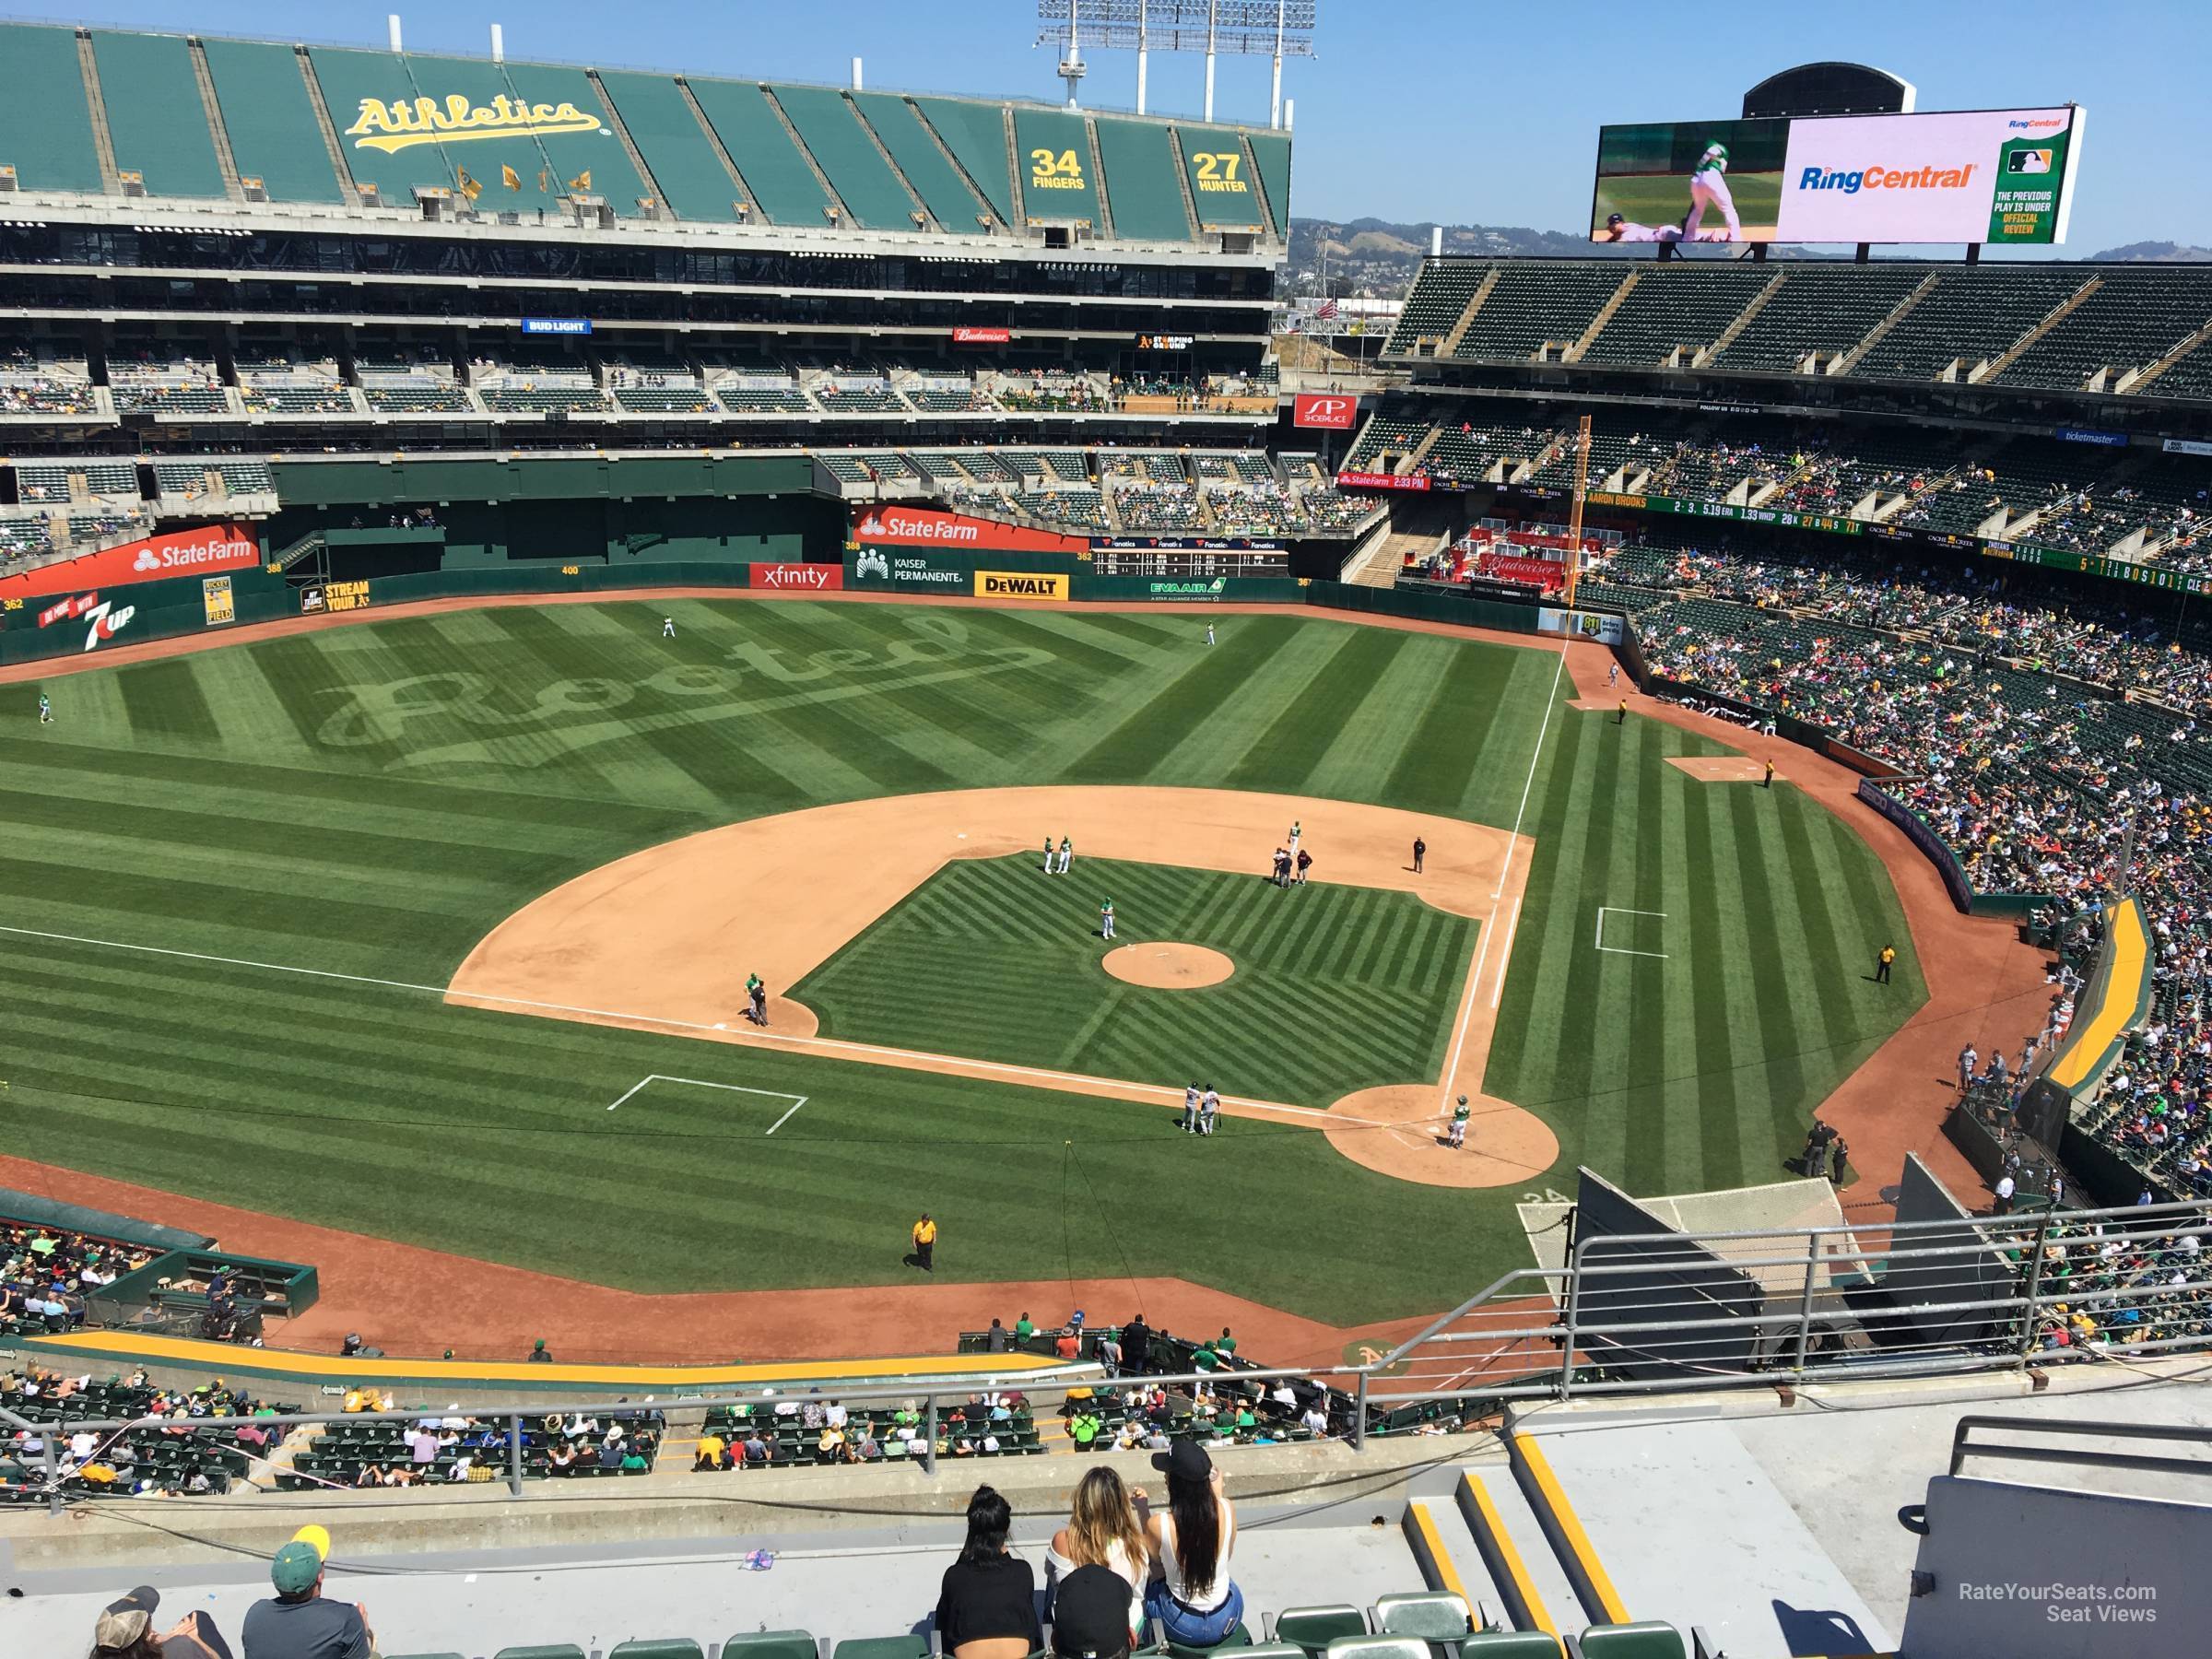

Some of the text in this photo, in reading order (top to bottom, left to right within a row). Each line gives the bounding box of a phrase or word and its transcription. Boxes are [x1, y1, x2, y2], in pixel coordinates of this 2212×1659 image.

[345, 94, 601, 147] Athletics
[1031, 149, 1081, 177] 34
[1193, 153, 1241, 181] 27
[1032, 176, 1085, 190] FINGERS
[1799, 164, 1974, 194] RingCentral
[1198, 180, 1247, 193] HUNTER
[1997, 192, 2053, 201] THE PREVIOUS
[1994, 203, 2051, 212] PLAY IS UNDER
[2003, 214, 2039, 223] OFFICIAL
[2004, 225, 2035, 234] REVIEW
[529, 321, 585, 332] BUD LIGHT
[957, 328, 1006, 341] Budweiser
[2065, 430, 2113, 444] ticketmaster
[1394, 477, 1410, 488] 2:33
[1412, 478, 1424, 488] PM
[1588, 494, 1614, 505] AARON
[1615, 496, 1647, 508] BROOKS
[1703, 503, 1721, 515] 5.19
[1721, 507, 1733, 516] ERA
[1740, 508, 1758, 521] 1.33
[1759, 512, 1776, 522] WHIP
[1782, 513, 1793, 524] 28
[1802, 515, 1813, 527] 27
[1820, 518, 1832, 531] 44
[1077, 552, 1092, 561] 362
[562, 566, 579, 575] 400
[894, 558, 926, 570] KAISER
[1486, 554, 1556, 575] Budweiser
[2080, 557, 2088, 571] 5
[764, 565, 830, 590] xfinity
[894, 571, 964, 583] PERMANENTE
[2124, 566, 2131, 579] B
[2141, 570, 2148, 582] S
[325, 581, 370, 598] STREAM
[2187, 578, 2201, 592] CLE
[4, 597, 24, 612] 362
[326, 595, 356, 612] YOUR
[208, 609, 232, 621] FIELD
